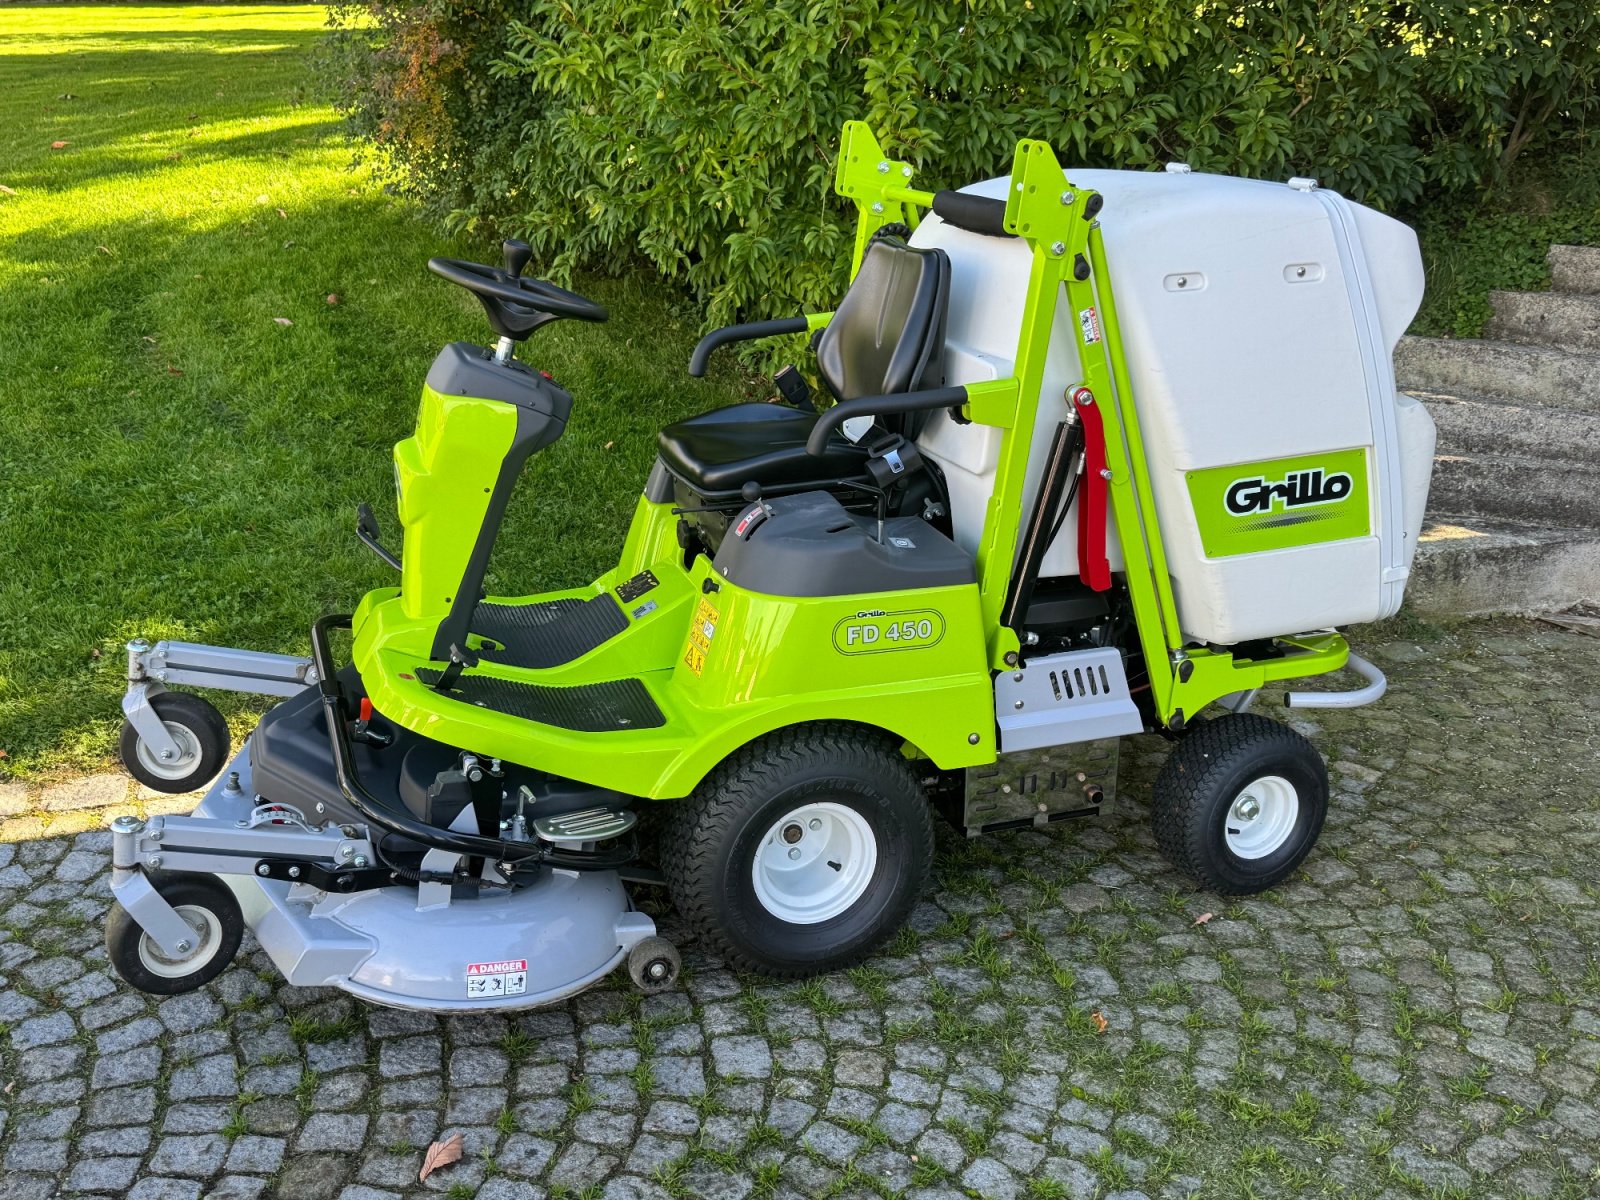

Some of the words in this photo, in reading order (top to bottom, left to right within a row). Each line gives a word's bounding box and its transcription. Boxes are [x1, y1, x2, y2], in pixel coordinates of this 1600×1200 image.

[1224, 468, 1352, 516] Grillo
[857, 610, 886, 618] Grillo
[847, 625, 880, 645] FD
[885, 620, 932, 641] 450
[480, 962, 522, 973] DANGER
